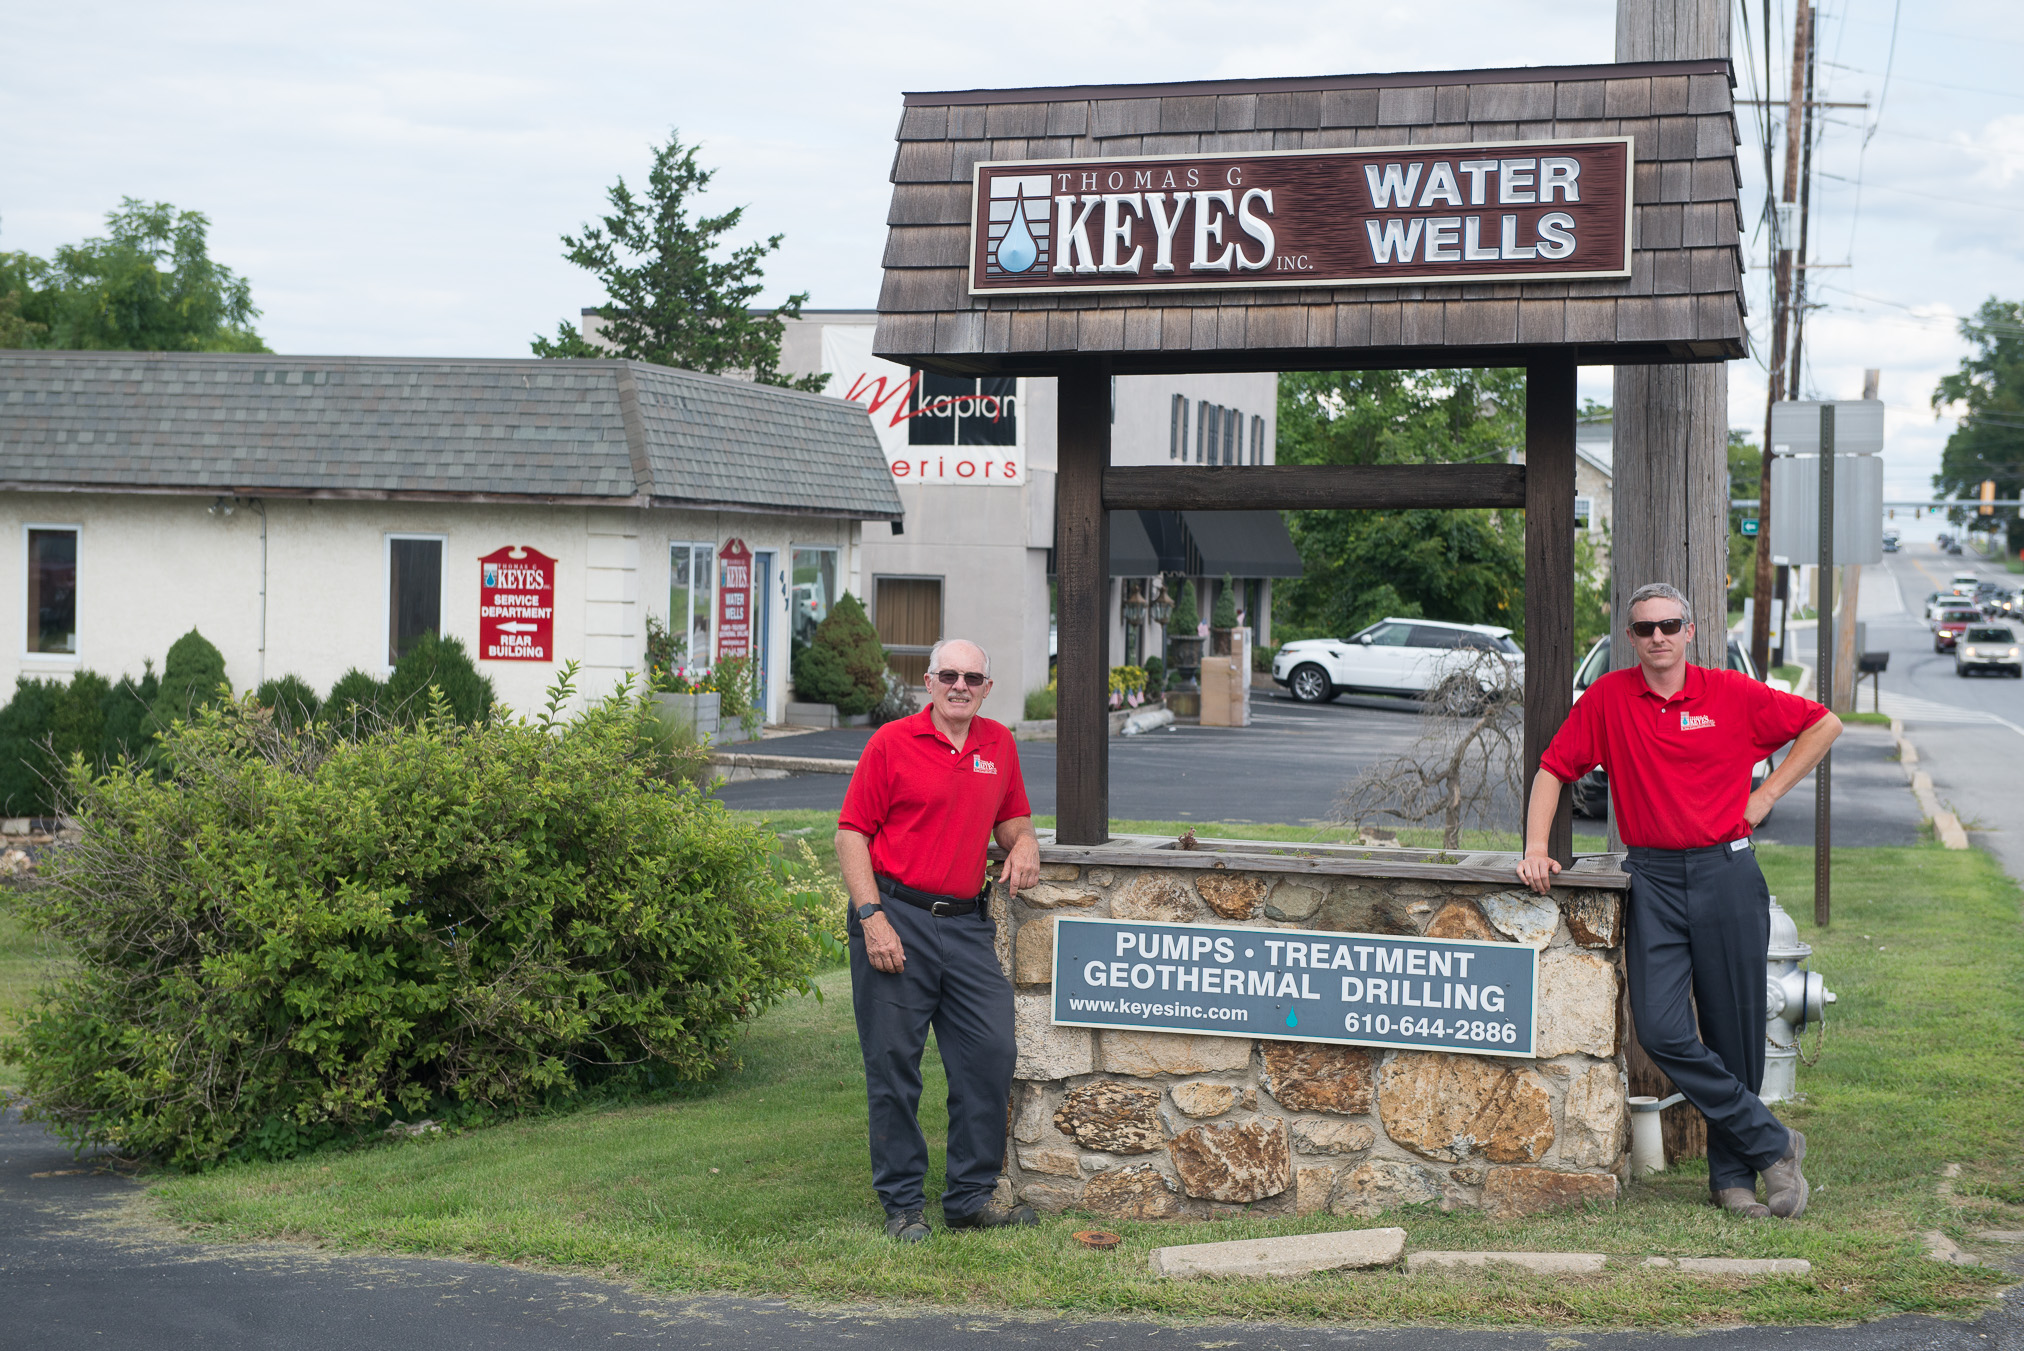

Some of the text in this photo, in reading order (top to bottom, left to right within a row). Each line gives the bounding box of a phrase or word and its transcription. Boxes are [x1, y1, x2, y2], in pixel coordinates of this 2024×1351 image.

[1057, 167, 1243, 191] THOMAS G
[1364, 157, 1580, 209] WATER
[1053, 188, 1314, 275] KEYES INC.
[1365, 212, 1576, 263] WELLS
[918, 370, 1017, 445] kaplan
[497, 569, 544, 590] KEYES
[494, 594, 539, 606] SERVICE
[725, 593, 744, 606] WATER
[481, 606, 552, 619] DEPARTMENT
[725, 607, 744, 620] WELLS
[488, 645, 544, 658] BUILDING
[500, 635, 532, 646] REAR
[1116, 931, 1475, 978] PUMPS TREATMENT
[1083, 960, 1505, 1013] GEOTHERMAL DRILLING
[1069, 998, 1248, 1021] www.keyesinc.com
[1344, 1012, 1517, 1043] 610-644-2886
